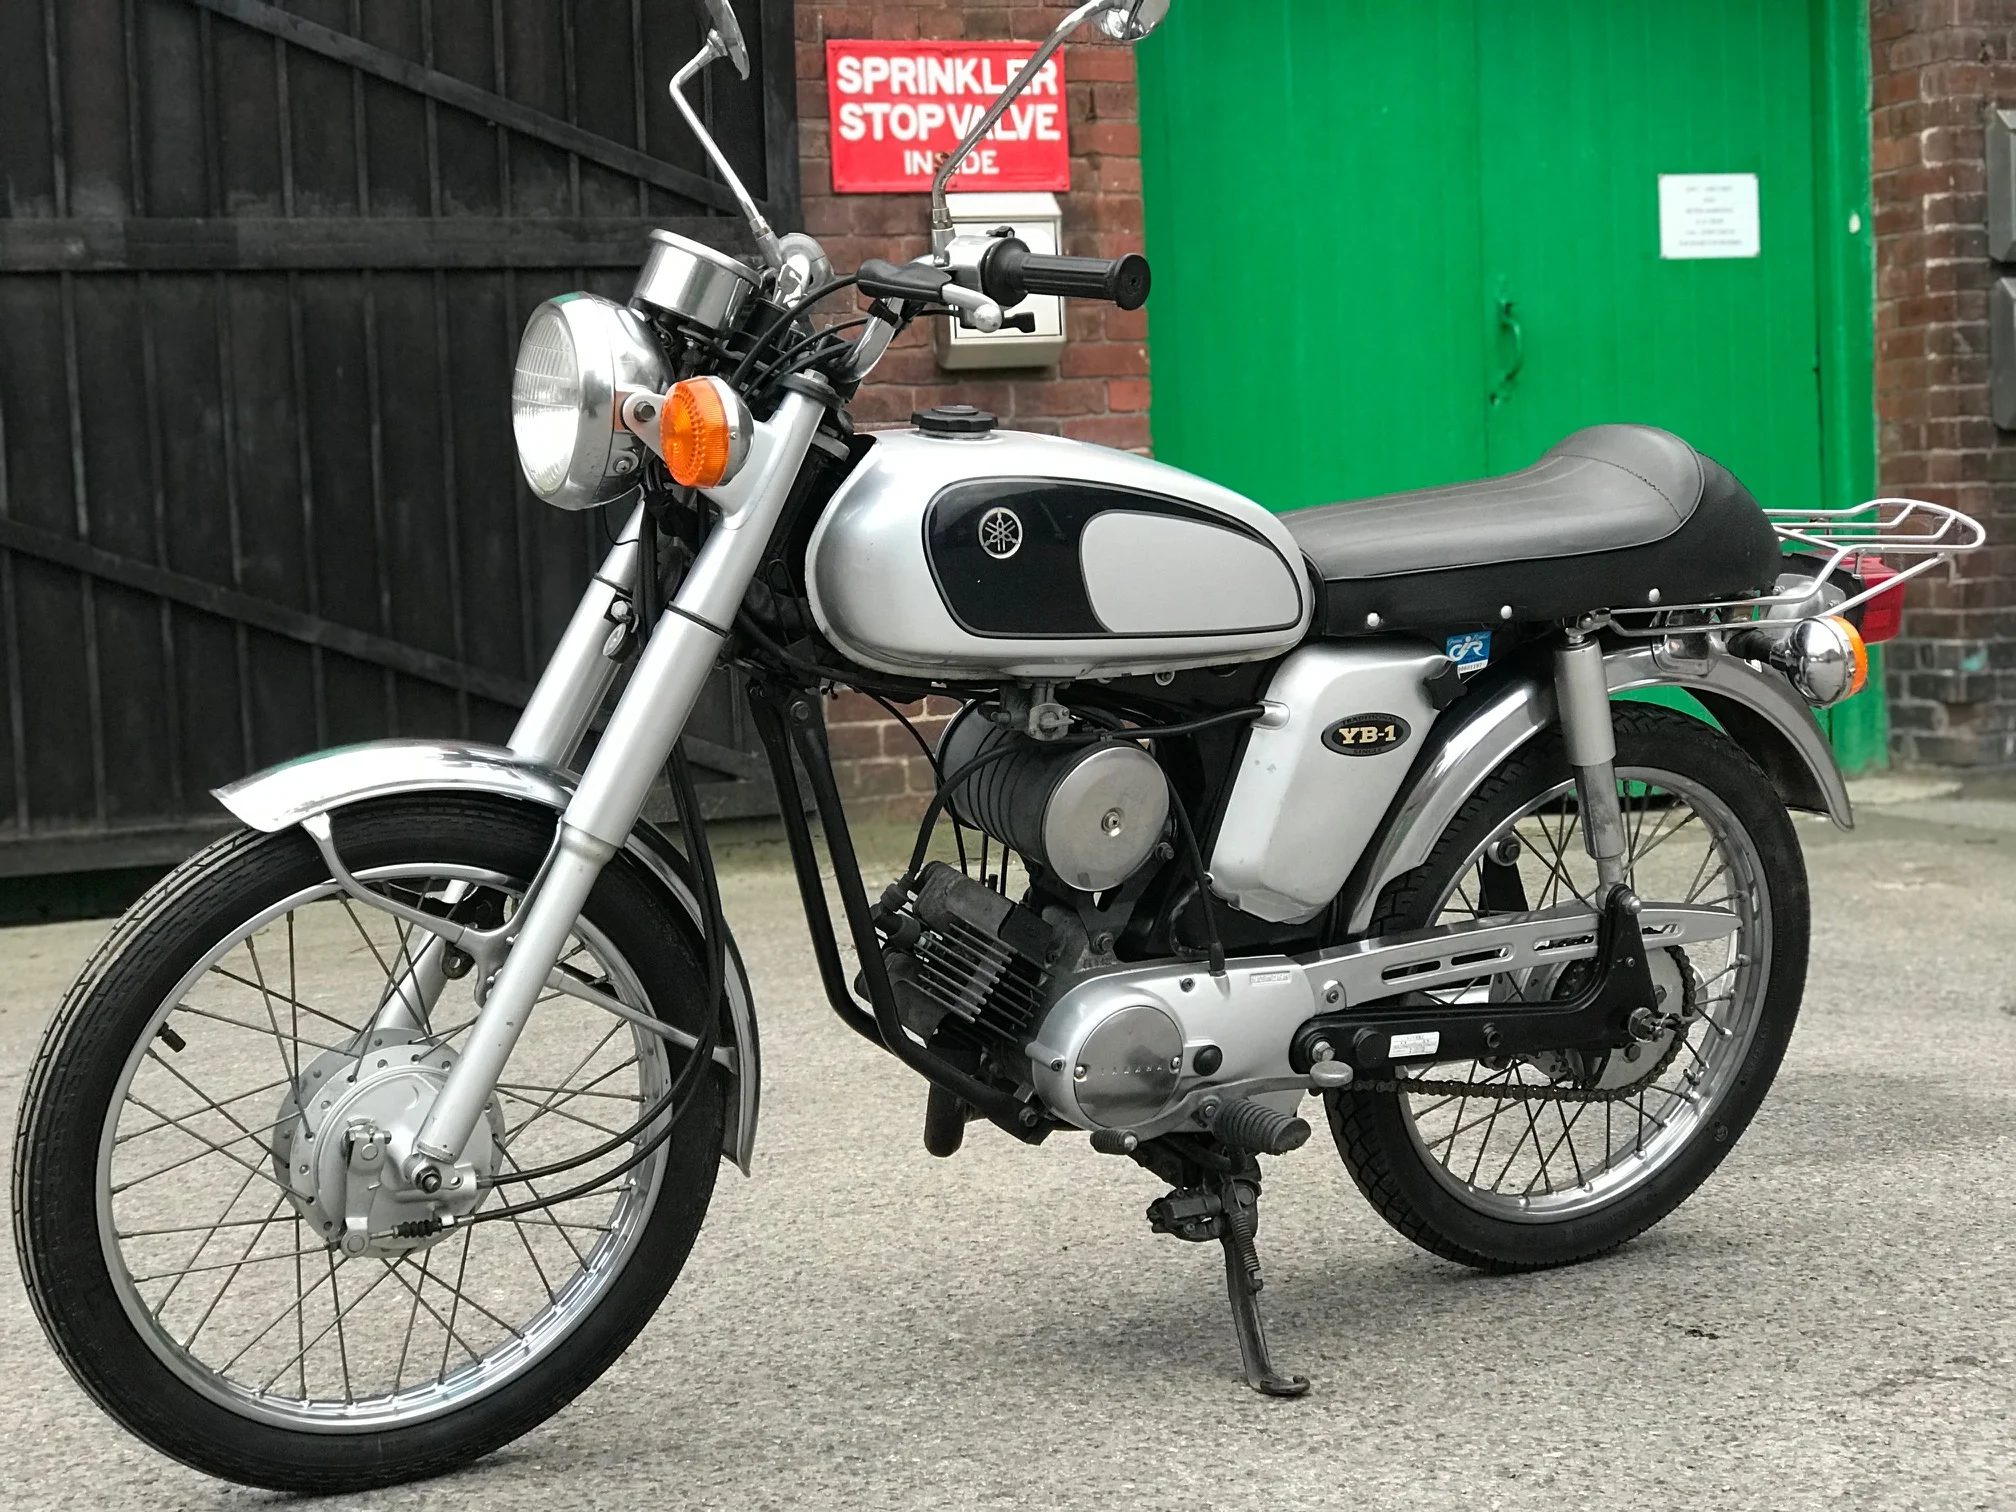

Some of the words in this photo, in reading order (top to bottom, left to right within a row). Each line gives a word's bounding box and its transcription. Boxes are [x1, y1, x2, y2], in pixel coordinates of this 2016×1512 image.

[836, 56, 1059, 95] SPRINKLER
[838, 103, 945, 141] STOP
[903, 150, 1000, 176] INDE
[1341, 714, 1397, 726] TRADITIONAL
[1339, 725, 1397, 744] YB-1
